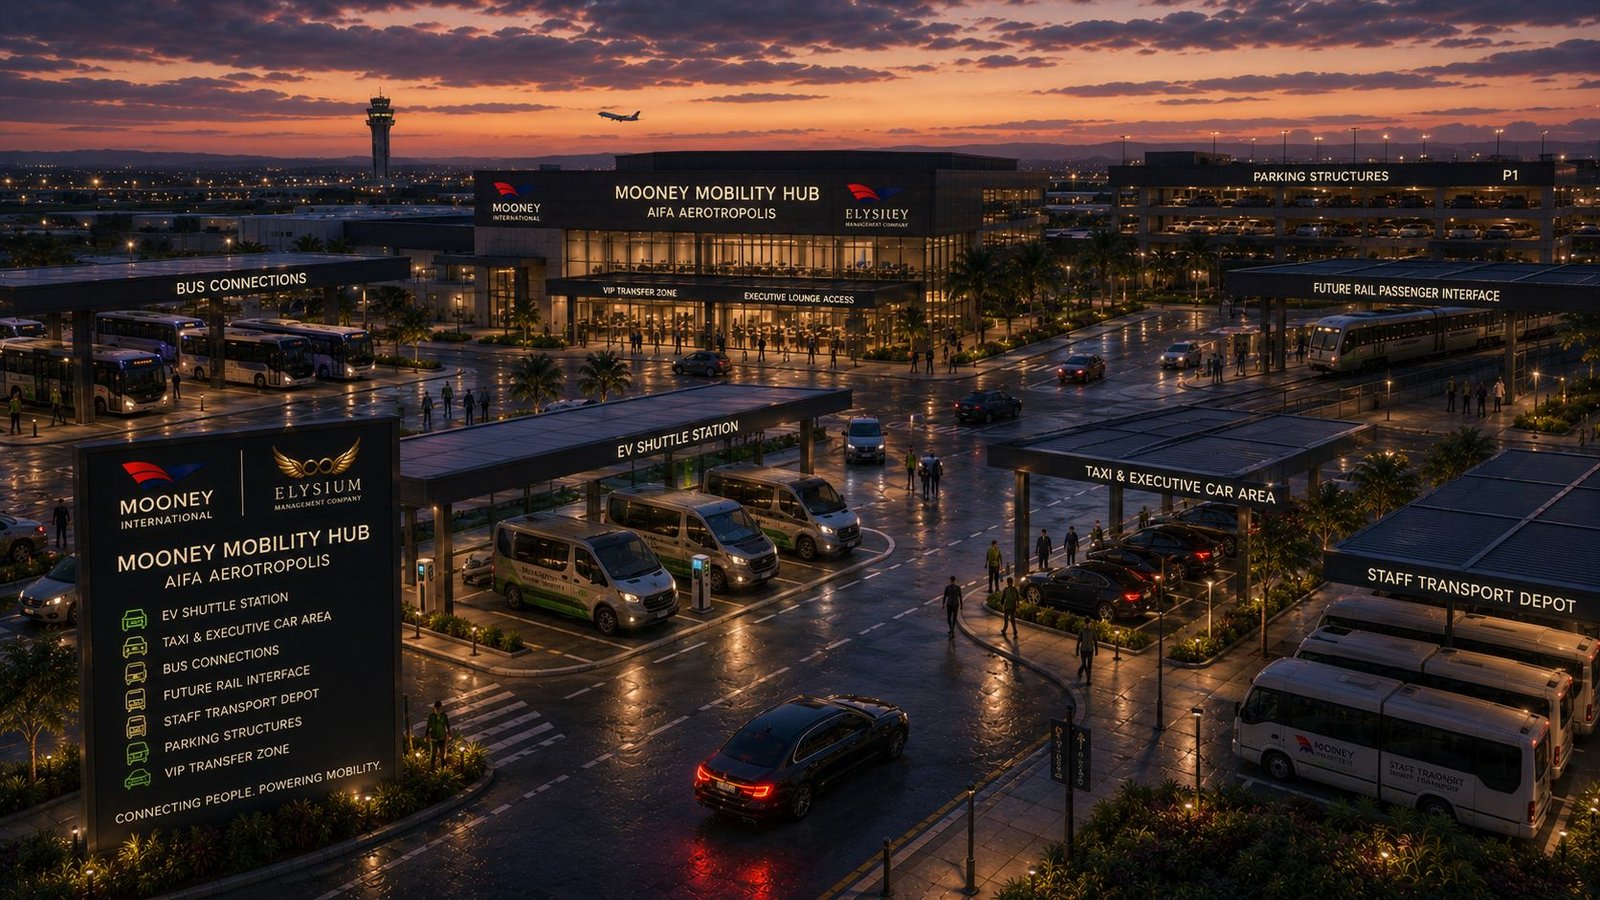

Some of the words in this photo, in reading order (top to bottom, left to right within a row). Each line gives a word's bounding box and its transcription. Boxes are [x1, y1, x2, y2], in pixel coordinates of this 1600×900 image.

[1253, 171, 1306, 183] PARKING
[1310, 171, 1390, 182] STRUCTURES
[1503, 169, 1519, 181] P1
[615, 185, 689, 200] MOONEY
[695, 185, 776, 201] MOBILITY
[783, 186, 820, 201] HUB
[492, 203, 541, 213] MOONEY
[647, 207, 675, 219] AIFA
[678, 207, 777, 220] AEROTROPOLIS
[176, 281, 205, 296] BUS
[210, 272, 307, 293] CONNECTIONS
[603, 287, 615, 295] VIP
[617, 287, 655, 296] TRANSFER
[656, 288, 678, 297] ZONE
[744, 292, 787, 302] EXECUTIVE
[788, 293, 821, 303] LOUNGE
[823, 295, 855, 304] ACCESS
[1313, 282, 1351, 295] FUTURE
[1354, 284, 1376, 296] RAIL
[1379, 285, 1439, 300] PASSENGER
[1442, 287, 1500, 302] INTERFACE
[617, 444, 634, 459] EV
[637, 430, 689, 455] SHUTTLE
[692, 420, 740, 443] STATION
[275, 478, 361, 500] ELYSIUM
[1085, 465, 1112, 481] TAXI
[1116, 469, 1126, 483] &
[1129, 472, 1201, 493] EXECUTIVE
[1205, 482, 1234, 498] CAR
[1238, 487, 1277, 505] AREA
[120, 489, 214, 516] MOONEY
[274, 499, 325, 511] MANAGEMENT
[326, 494, 362, 505] COMPANY
[121, 511, 213, 530] INTERNATIONAL
[117, 543, 216, 573] MOONEY
[223, 530, 322, 558] MOBILITY
[328, 524, 371, 545] HUB
[165, 571, 203, 590] AIFA
[209, 554, 331, 583] AEROTROPOLIS
[1367, 567, 1413, 587] STAFF
[1417, 575, 1514, 604] TRANSPORT
[1519, 592, 1577, 614] DEPOT
[162, 608, 179, 622] EV
[182, 598, 237, 618] SHUTTLE
[240, 592, 289, 609] STATION
[162, 634, 189, 648] TAXI
[193, 632, 202, 643] &
[206, 620, 271, 641] EXECUTIVE
[274, 617, 298, 631] CAR
[301, 611, 332, 626] AREA
[163, 660, 188, 675] BUS
[191, 645, 280, 669] CONNECTIONS
[164, 683, 213, 701] FUTURE
[216, 677, 243, 692] RAIL
[246, 665, 311, 686] INTERFACE
[164, 710, 201, 727] STAFF
[205, 696, 277, 720] TRANSPORT
[280, 688, 320, 705] DEPOT
[164, 732, 220, 753] PARKING
[223, 716, 303, 742] STRUCTURES
[164, 765, 185, 779] VIP
[189, 751, 253, 773] TRANSFER
[256, 743, 290, 760] ZONE
[115, 798, 201, 824] CONNECTING
[205, 786, 256, 806] PEOPLE.
[259, 772, 323, 794] POWERING
[326, 760, 382, 780] MOBILITY.
